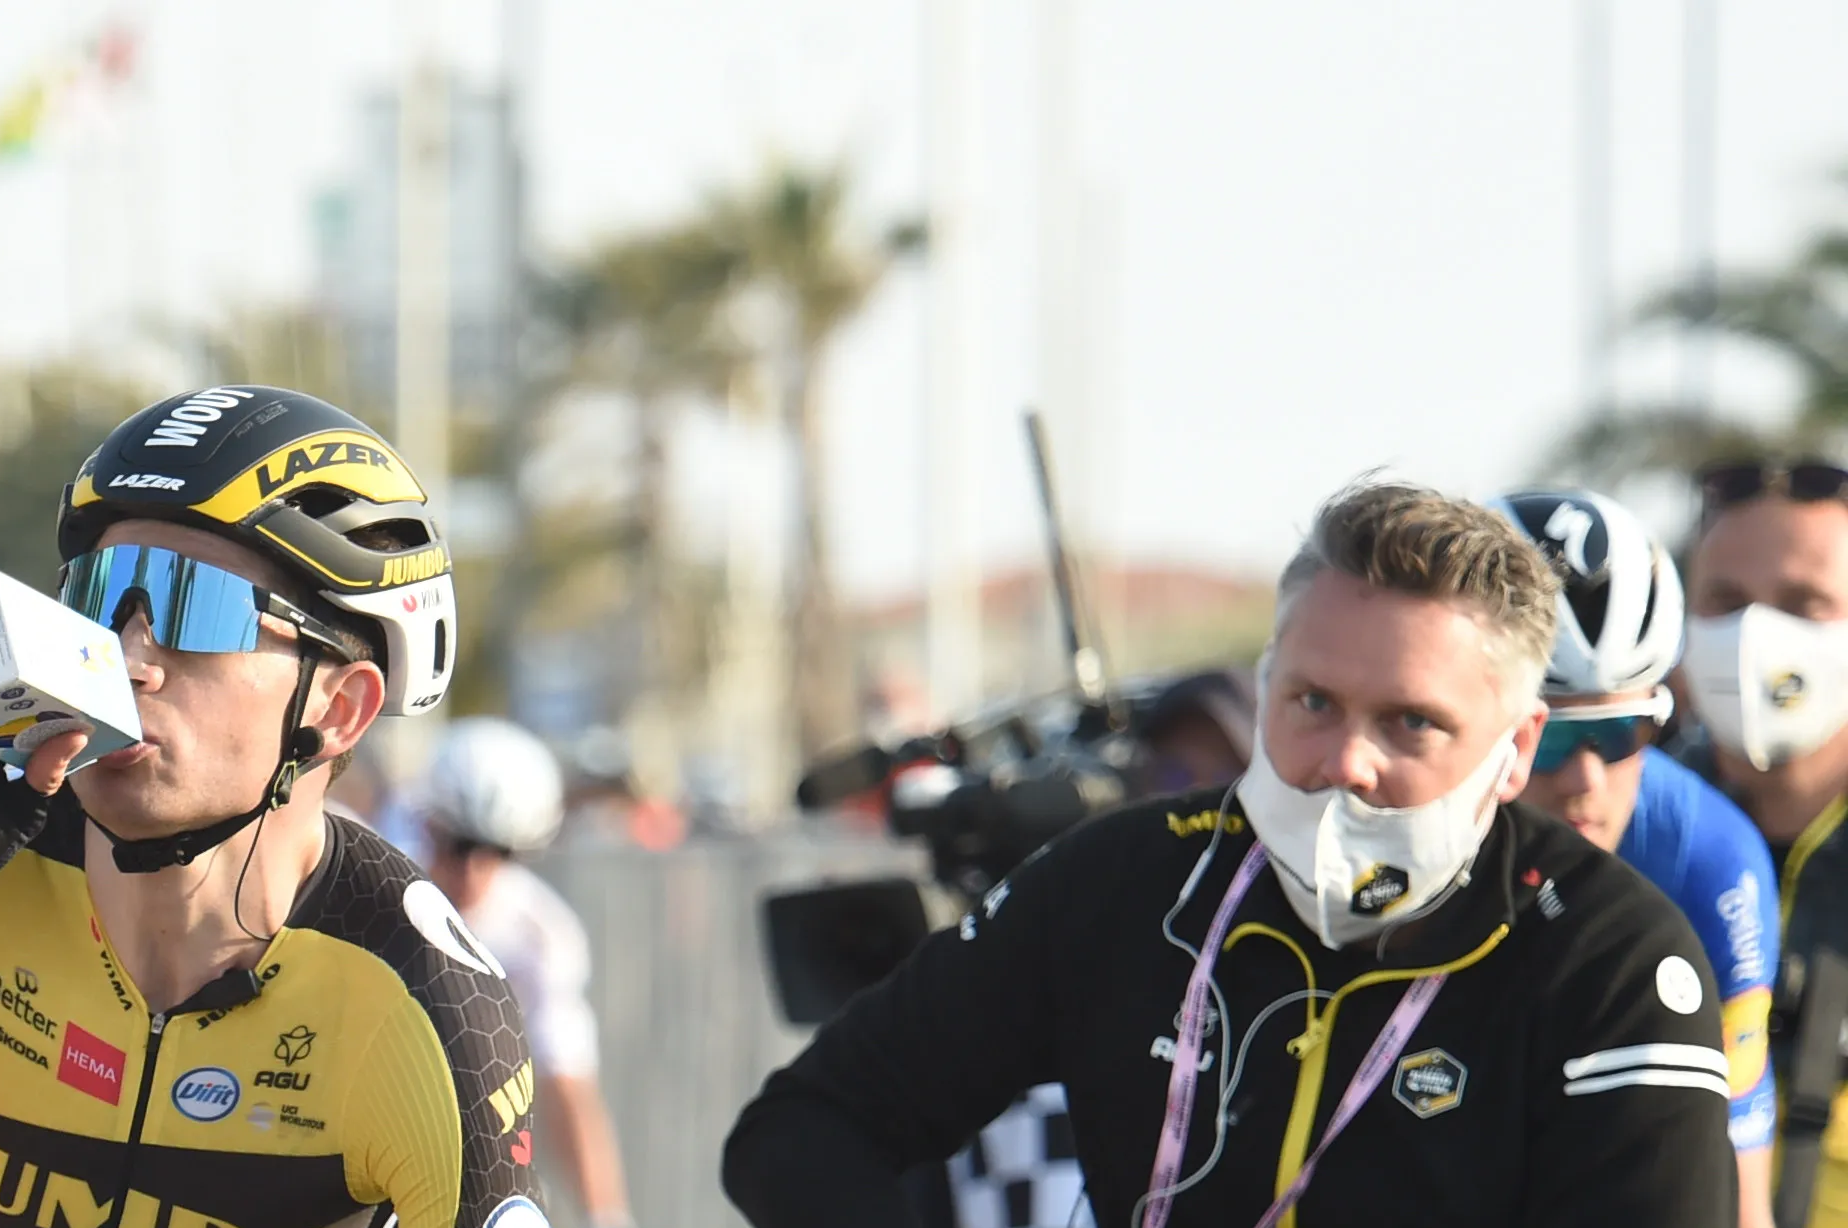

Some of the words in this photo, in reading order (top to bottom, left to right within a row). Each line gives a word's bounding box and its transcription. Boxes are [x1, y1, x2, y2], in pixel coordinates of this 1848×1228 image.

[144, 387, 255, 447] WOUT
[108, 474, 186, 492] LAZER
[255, 442, 392, 499] LAZER
[379, 546, 444, 588] JUMBO
[66, 1045, 117, 1084] HEMA
[253, 1070, 311, 1092] AGU
[281, 1103, 299, 1115] UCI
